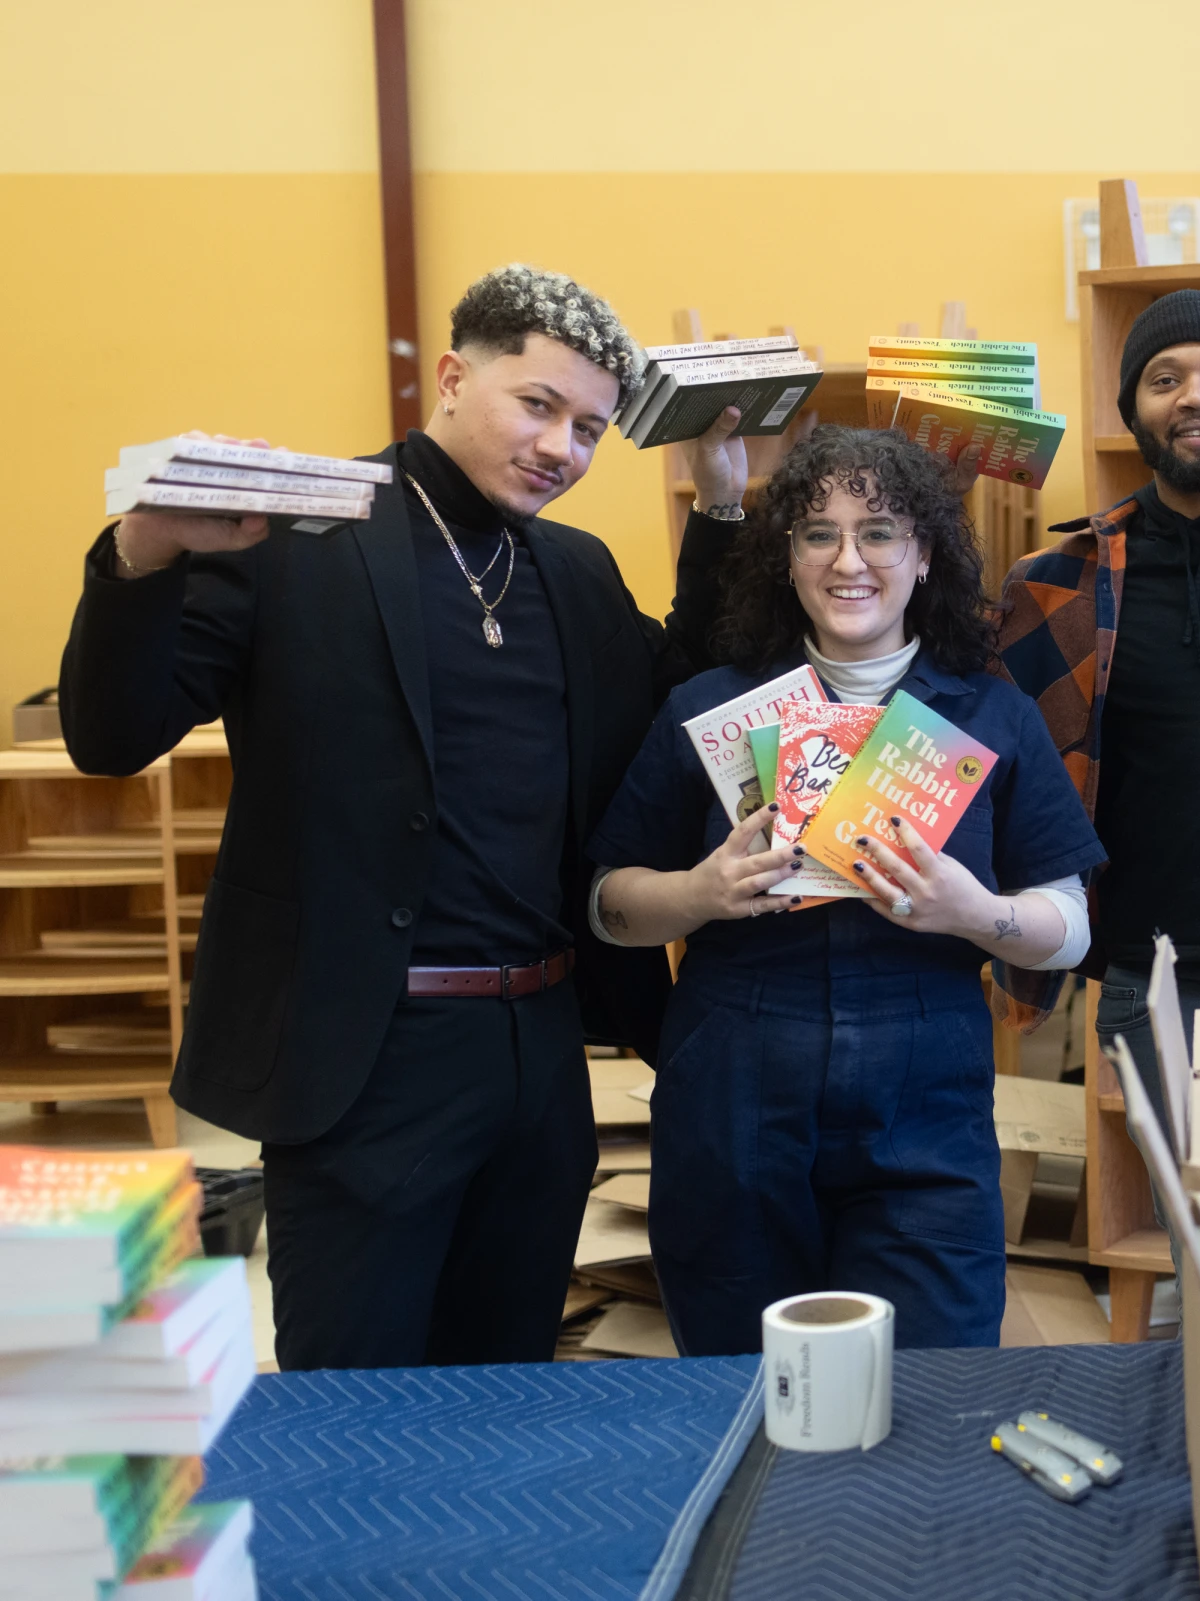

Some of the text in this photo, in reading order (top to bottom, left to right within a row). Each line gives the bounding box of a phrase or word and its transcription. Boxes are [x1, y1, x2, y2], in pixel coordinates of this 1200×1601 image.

[896, 338, 919, 346] Gunty
[981, 342, 1009, 350] Rabbit
[1009, 366, 1027, 374] The
[928, 391, 1059, 424] The Rabbit Hutch Tess Gunty
[914, 413, 941, 448] Gunt
[985, 424, 1019, 472] Rabbit
[1012, 436, 1040, 464] The
[711, 749, 735, 767] TO
[811, 734, 851, 775] Bes
[904, 725, 948, 769] The
[876, 741, 959, 808] Rabbit
[866, 766, 940, 829] Hutch
[799, 1342, 813, 1438] Freedom Reads
